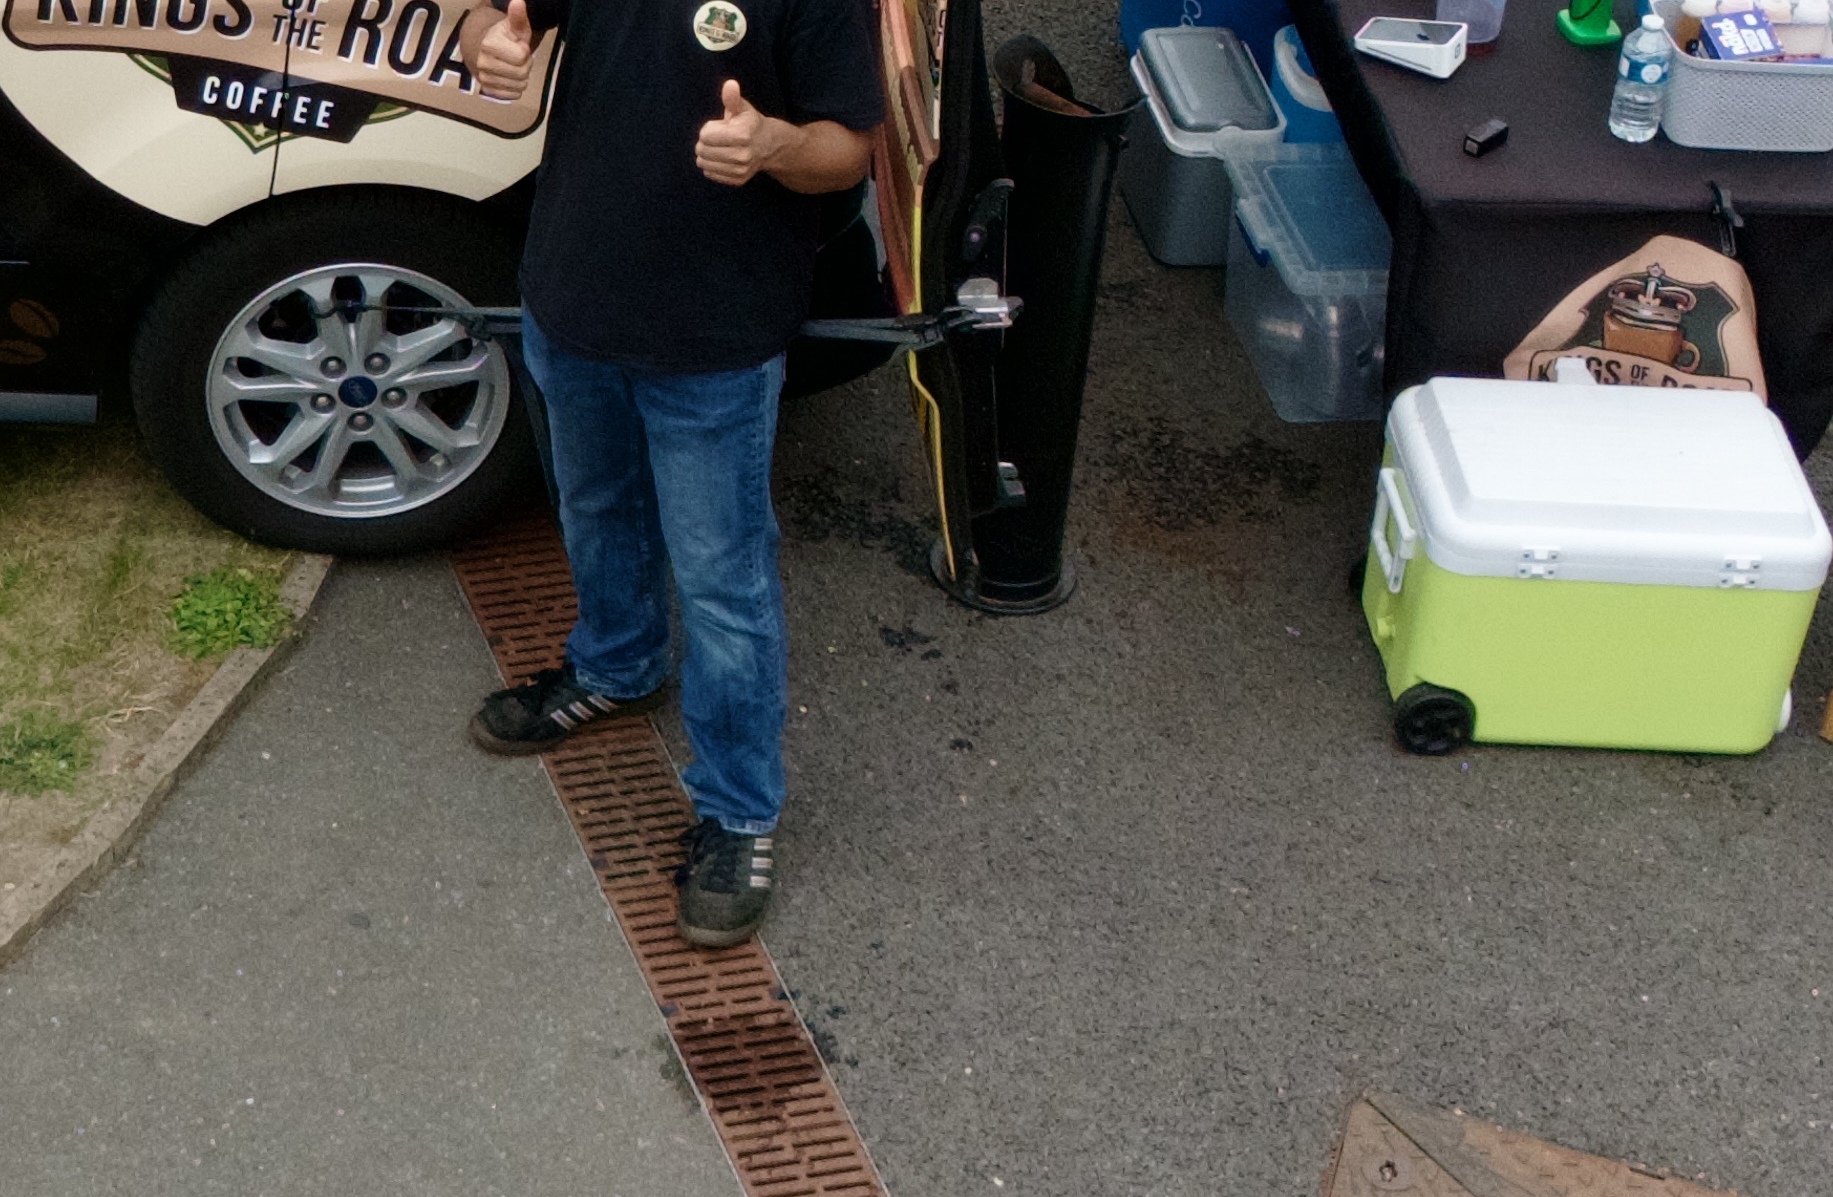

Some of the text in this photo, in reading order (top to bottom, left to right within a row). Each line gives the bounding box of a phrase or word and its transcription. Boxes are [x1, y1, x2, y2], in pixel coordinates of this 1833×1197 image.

[271, 14, 327, 53] THE
[202, 75, 336, 129] COFFEE
[1630, 364, 1651, 381] OF
